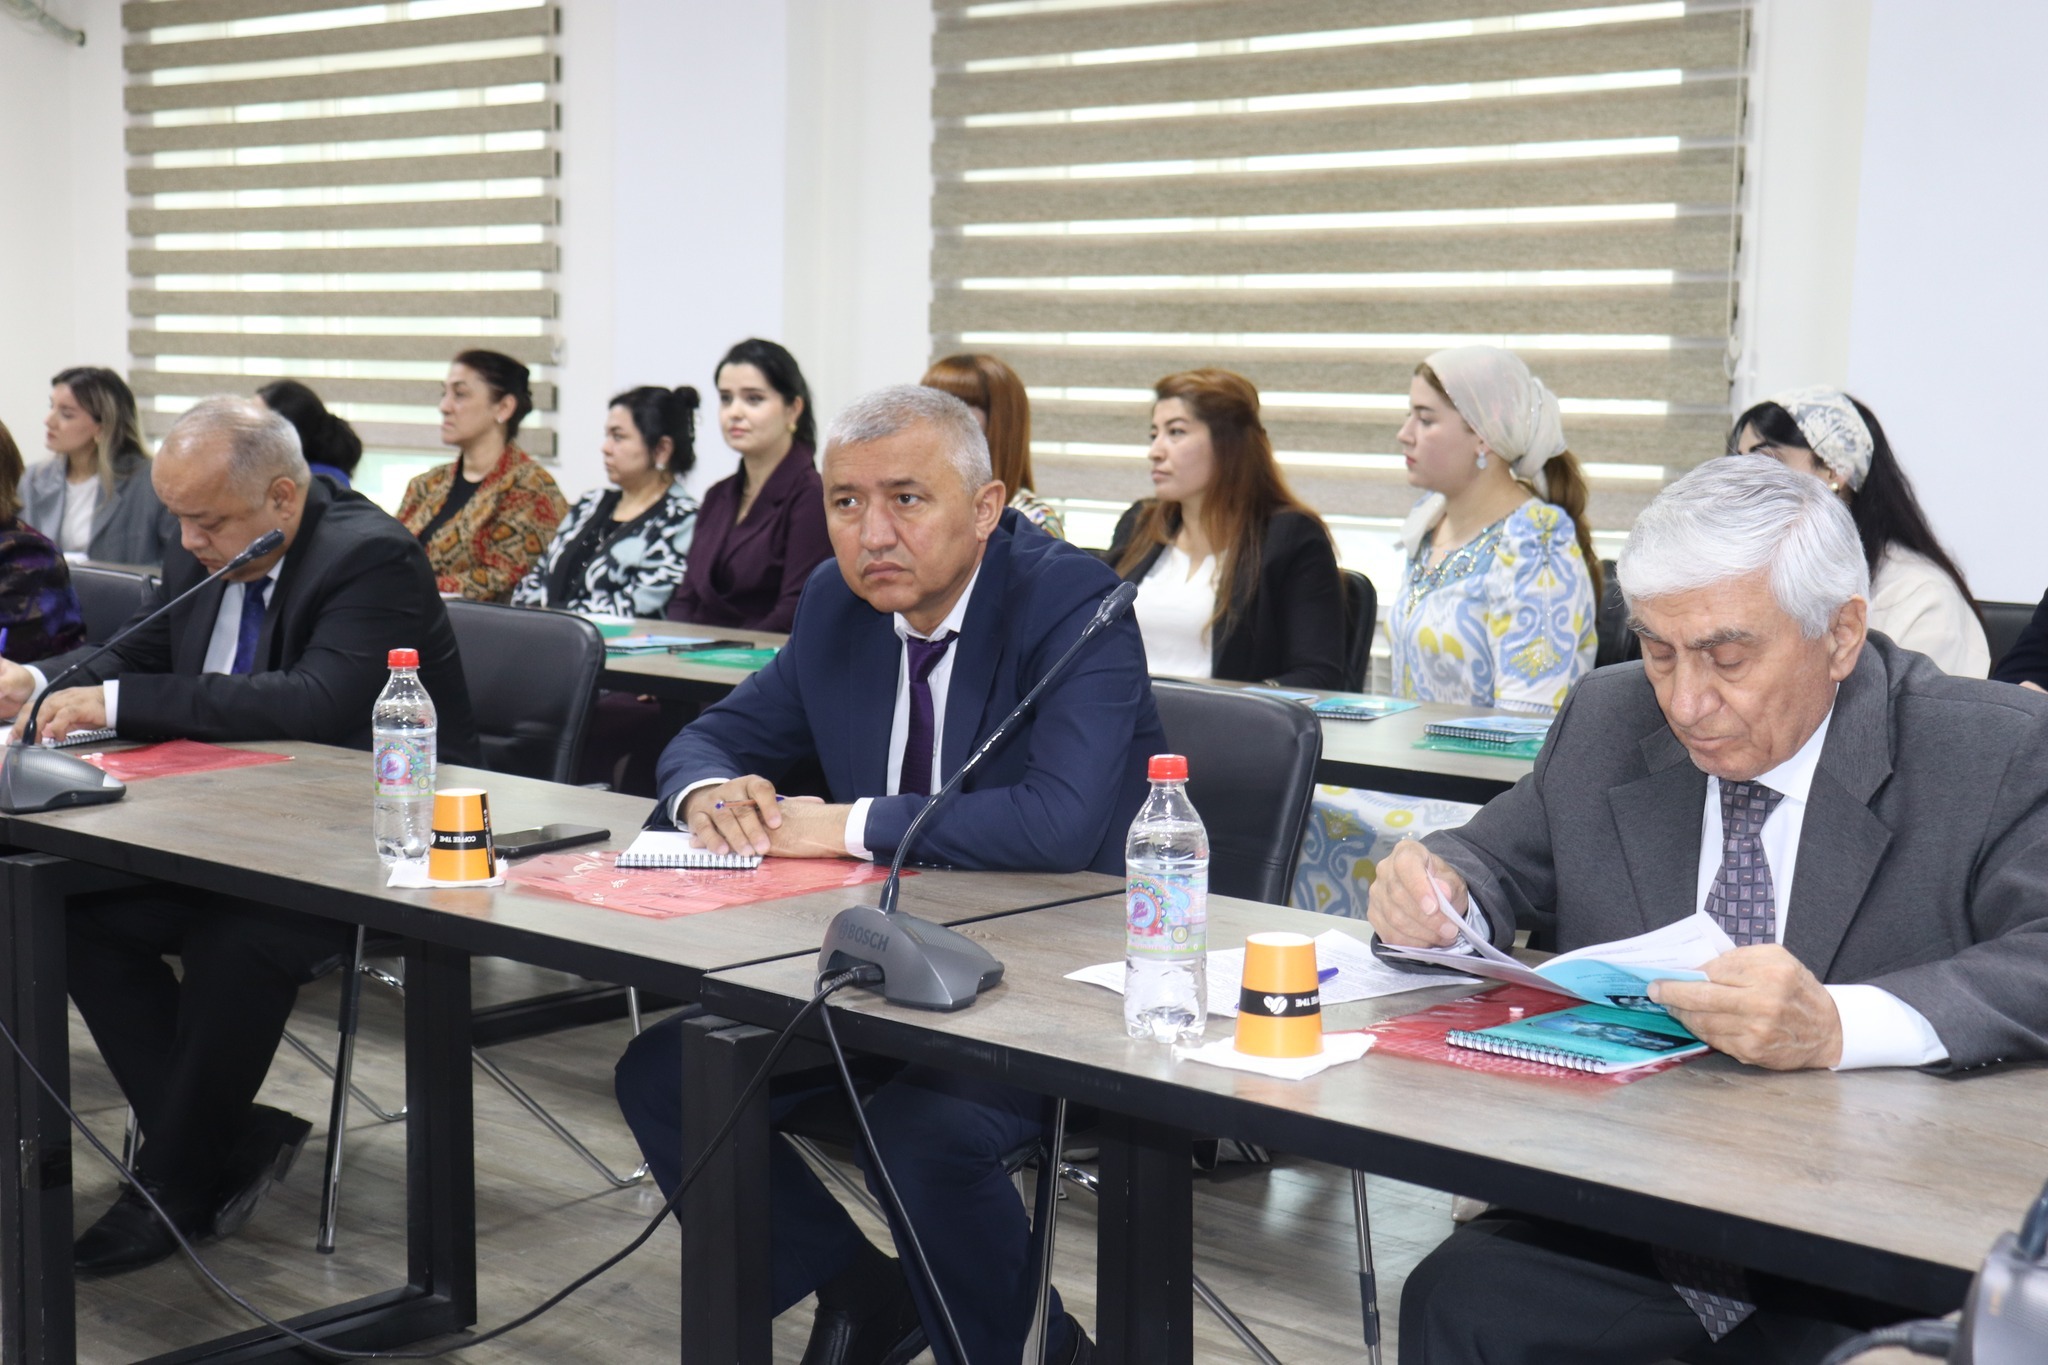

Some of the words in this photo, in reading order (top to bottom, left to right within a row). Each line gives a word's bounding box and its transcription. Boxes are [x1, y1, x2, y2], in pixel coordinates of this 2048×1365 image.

[439, 835, 452, 843] TIME
[453, 835, 477, 843] COFFEE
[847, 923, 890, 952] BOSCH
[1295, 997, 1310, 1008] TIME
